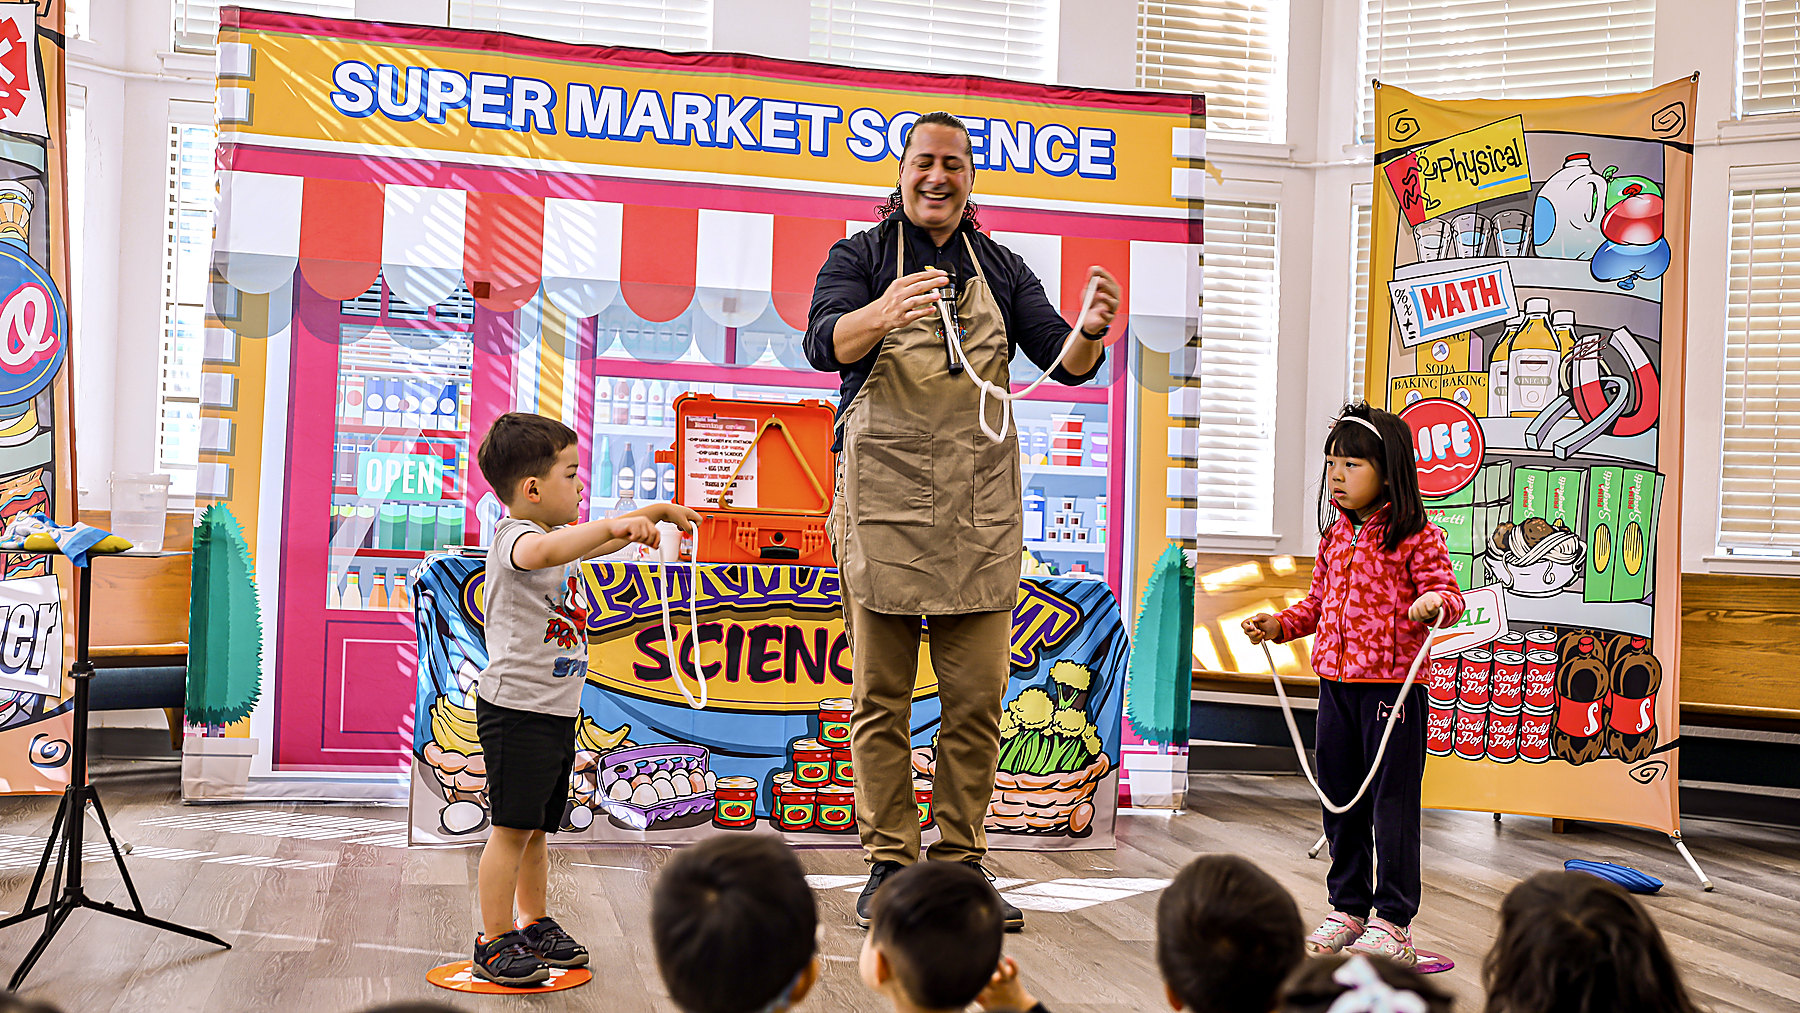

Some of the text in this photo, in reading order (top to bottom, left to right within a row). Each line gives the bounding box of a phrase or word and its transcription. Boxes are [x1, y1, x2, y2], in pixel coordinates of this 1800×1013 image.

[331, 60, 1117, 180] SUPER MARKET SCENCE
[1436, 138, 1523, 186] Physical
[1421, 275, 1501, 321] MATH
[1426, 363, 1456, 375] SODA
[1394, 378, 1438, 390] BAKING
[1442, 375, 1486, 387] BAKING
[1517, 377, 1549, 386] VINEGAR
[1414, 420, 1472, 462] IFE
[366, 458, 435, 494] OPEN
[1523, 475, 1535, 518] Spaghetti
[1554, 476, 1566, 520] Spaghetti
[1598, 470, 1612, 521] Spaghetti
[1627, 486, 1635, 509] PRIMA
[1628, 473, 1644, 523] Spaghetti
[633, 623, 853, 684] SCIENC
[1431, 662, 1456, 679] Sody
[1462, 666, 1489, 682] Sody
[1494, 669, 1521, 684] Sody
[1526, 668, 1555, 684] Sody
[1429, 676, 1455, 692] Pop
[1461, 679, 1488, 696] Pop
[1494, 682, 1521, 698] Pop
[1526, 682, 1554, 699] Pop
[1427, 713, 1451, 729] Sody
[1457, 717, 1484, 732] Sody
[1489, 720, 1517, 735] Sody
[1521, 720, 1550, 735] Sody
[1427, 727, 1450, 742] Pop
[1456, 731, 1483, 746] Pop
[1488, 734, 1516, 750] Pop
[1520, 734, 1548, 750] Pop
